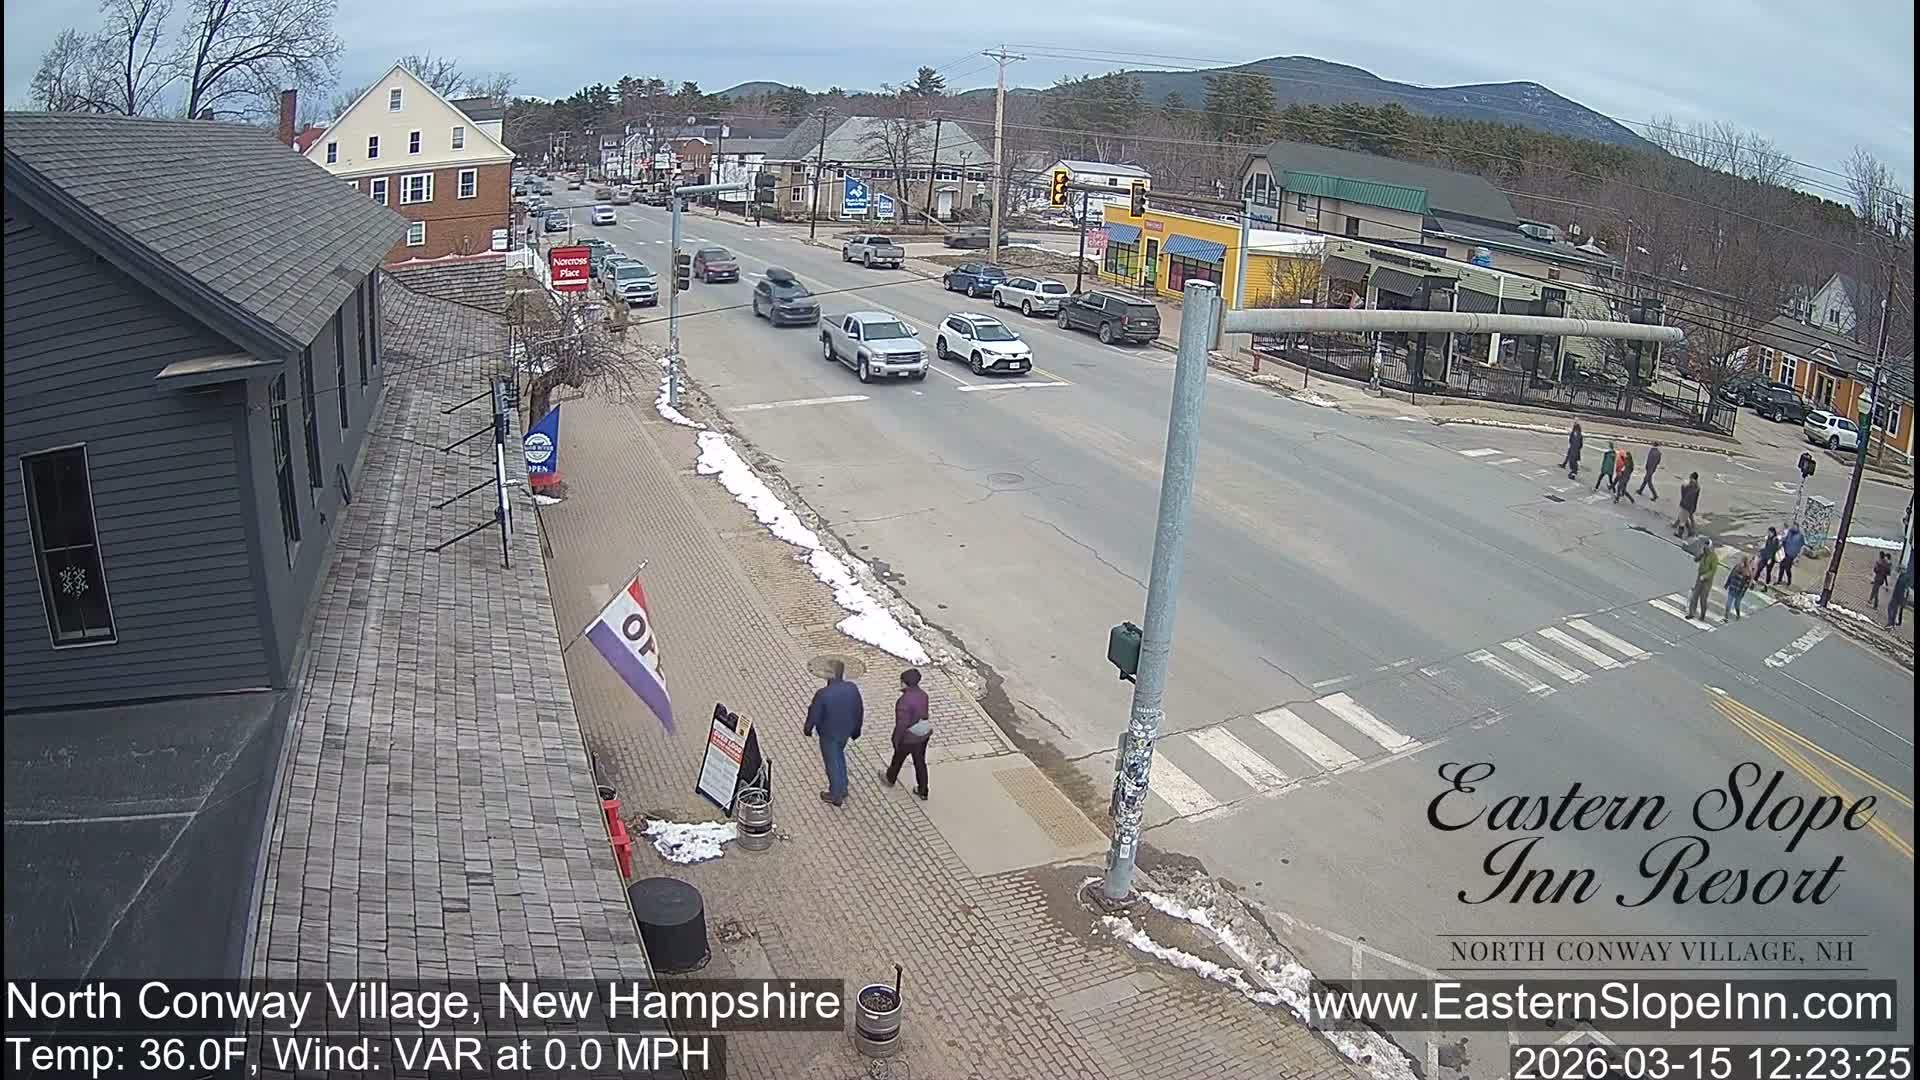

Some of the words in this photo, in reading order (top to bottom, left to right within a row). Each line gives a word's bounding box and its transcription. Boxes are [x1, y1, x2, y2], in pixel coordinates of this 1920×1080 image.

[553, 257, 588, 268] Norcross
[560, 270, 580, 280] Place
[528, 465, 549, 473] OPEN
